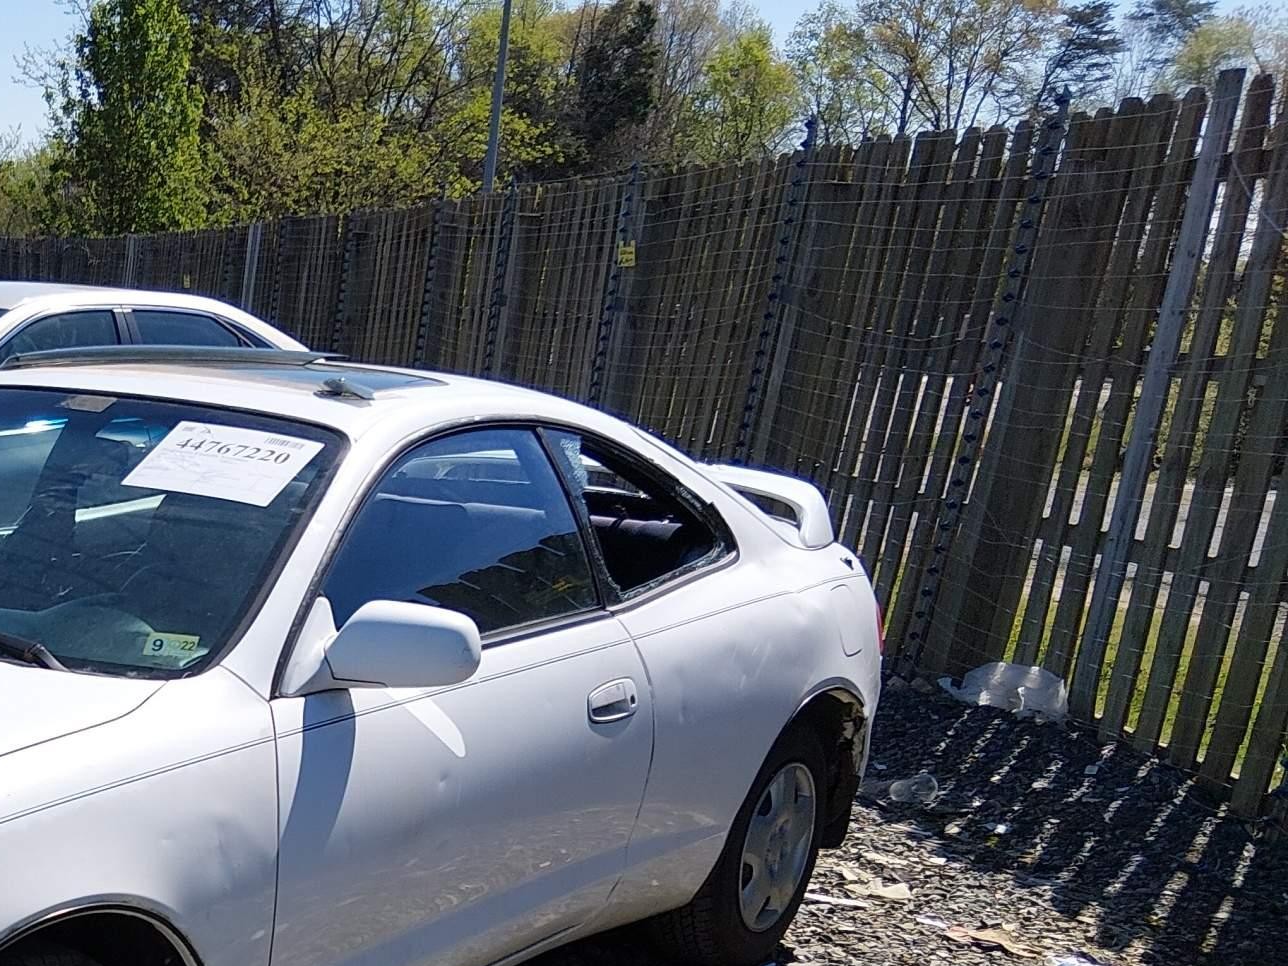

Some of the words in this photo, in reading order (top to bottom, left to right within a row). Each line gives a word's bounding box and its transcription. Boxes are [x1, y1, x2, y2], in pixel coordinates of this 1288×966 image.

[176, 437, 291, 465] 44767220
[151, 638, 164, 652] 9
[180, 640, 196, 652] 22
